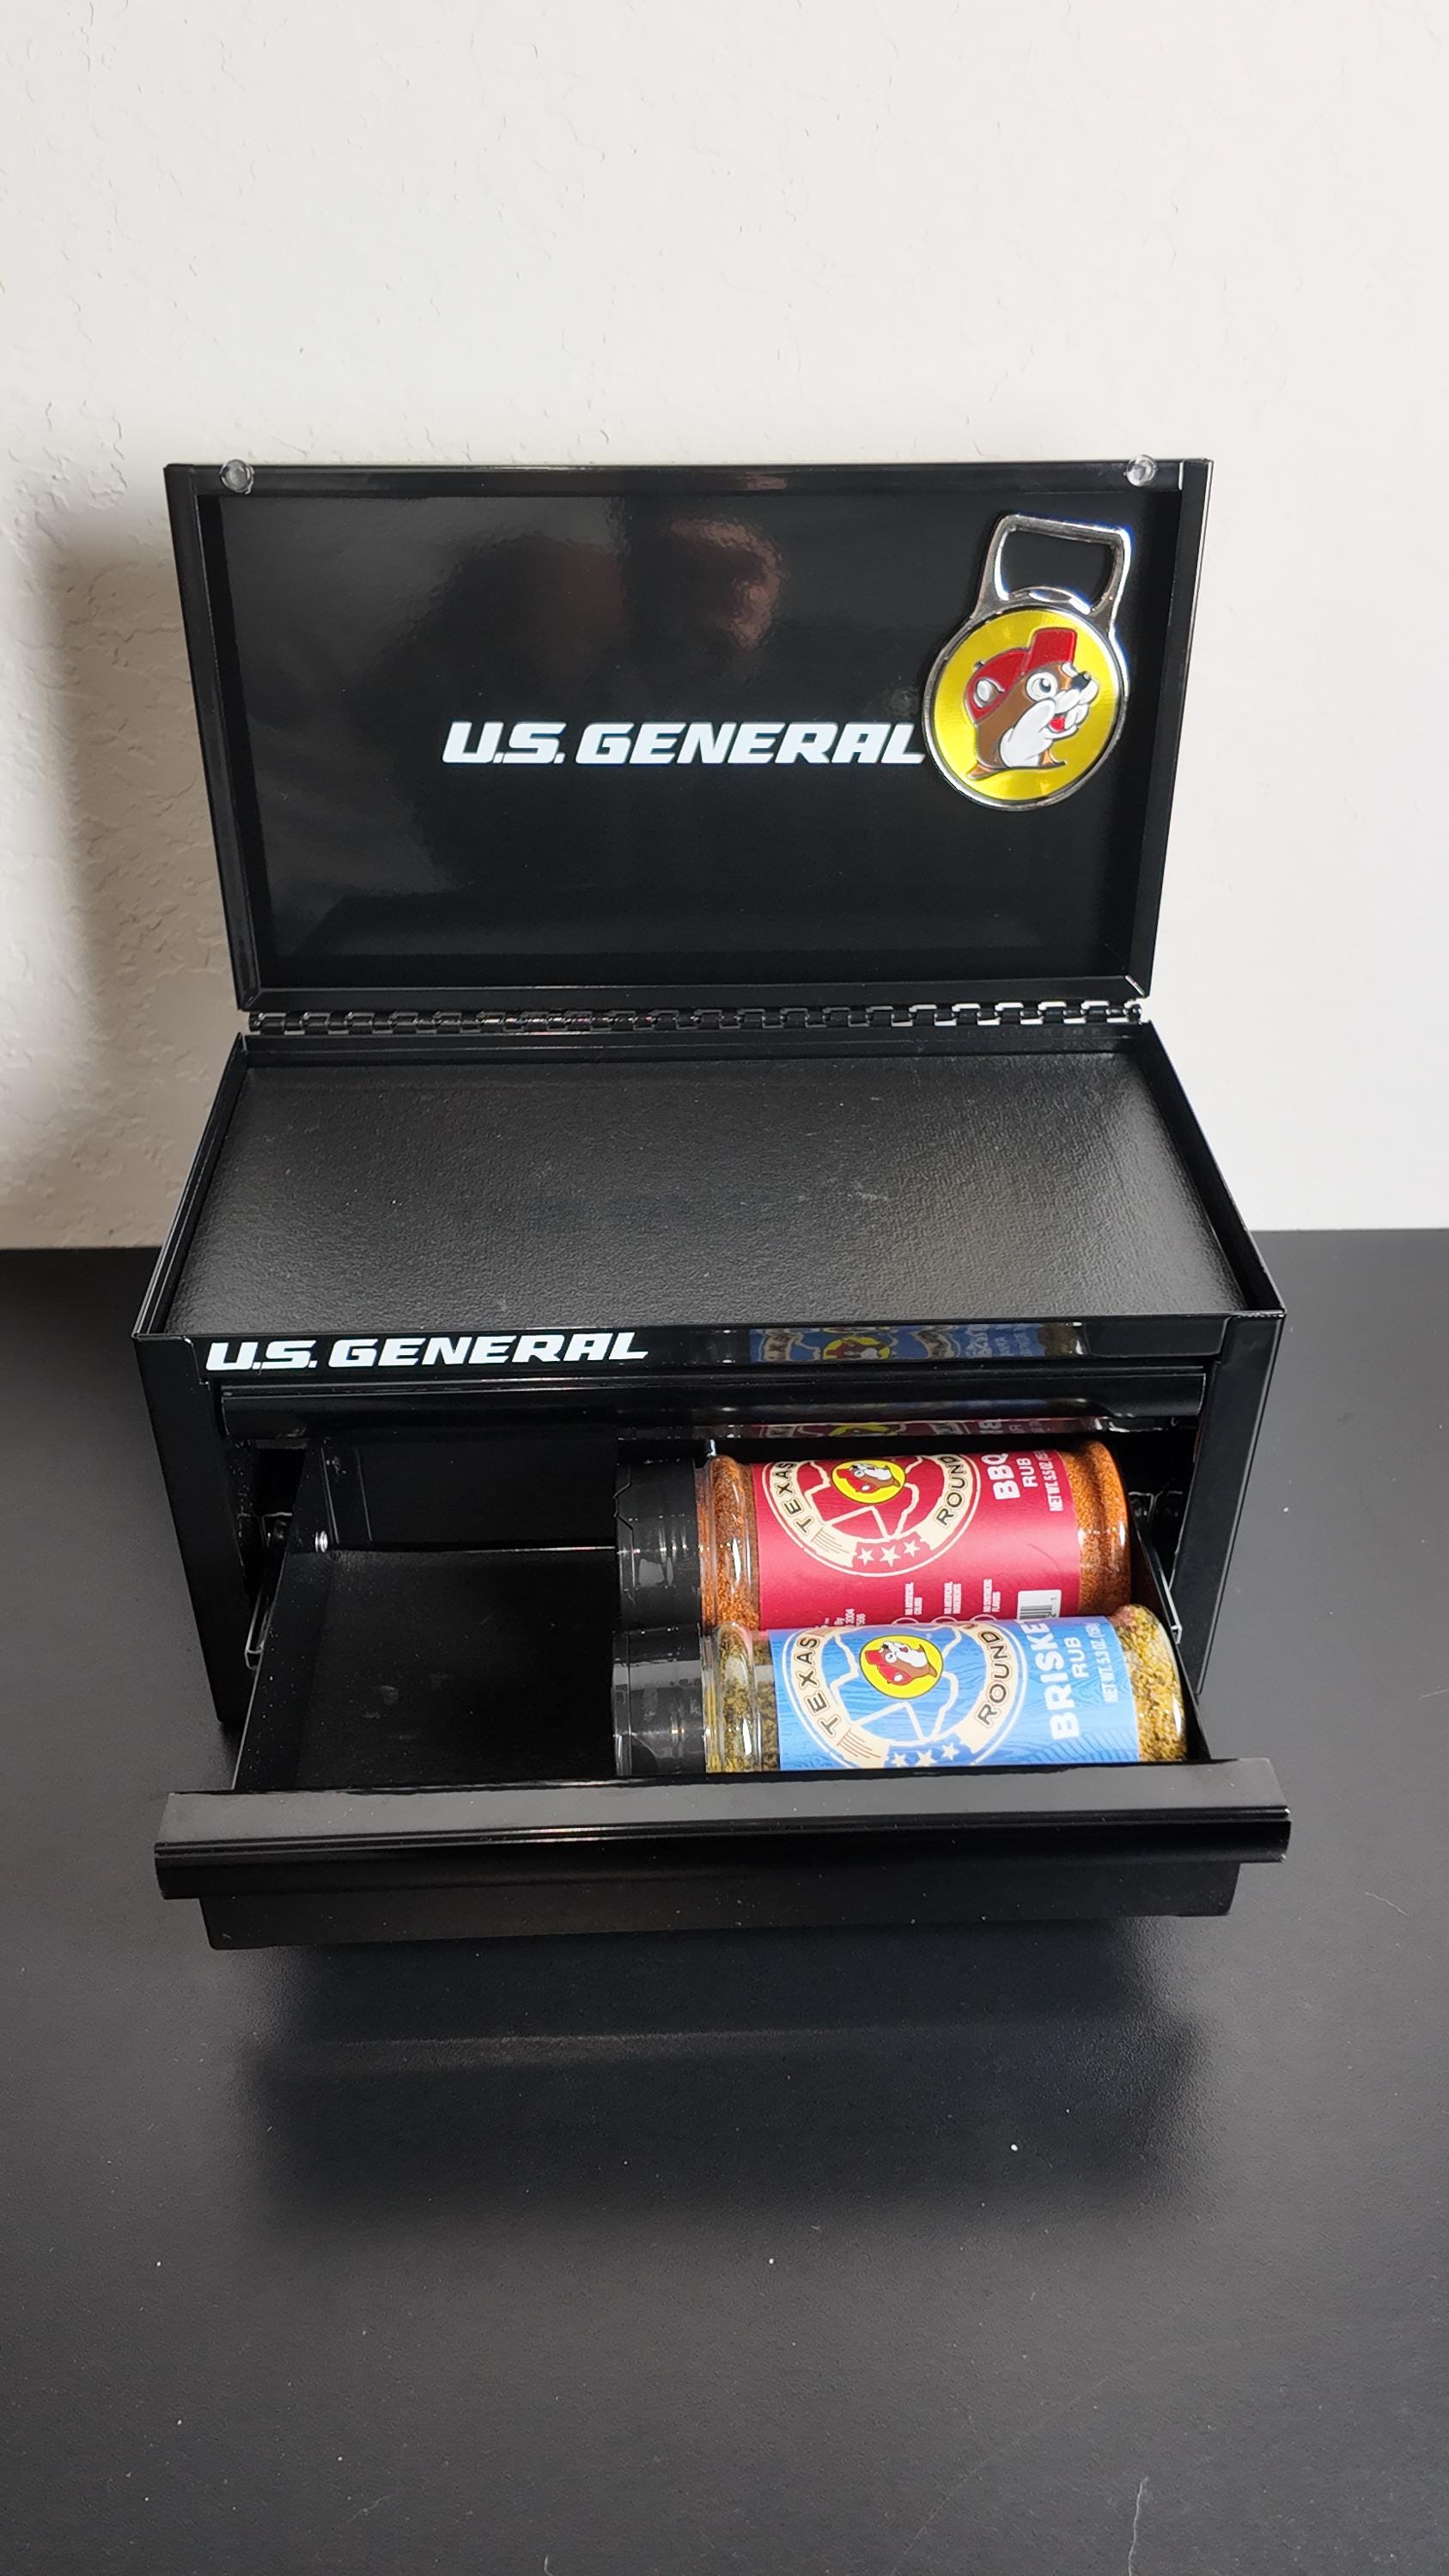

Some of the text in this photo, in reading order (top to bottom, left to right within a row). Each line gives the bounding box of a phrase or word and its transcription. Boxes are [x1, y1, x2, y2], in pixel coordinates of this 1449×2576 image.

[441, 721, 926, 763] U.S. GENERAL
[205, 1332, 648, 1371] U.S. GENERAL
[981, 1453, 1020, 1500] BBQ
[1016, 1457, 1038, 1487] RUB
[775, 1455, 965, 1534] TEXAS ROUND
[1047, 1495, 1064, 1511] NET
[1063, 1637, 1090, 1679] RUB
[796, 1631, 1009, 1735] TEXAS ROUND
[1101, 1684, 1118, 1702] NET
